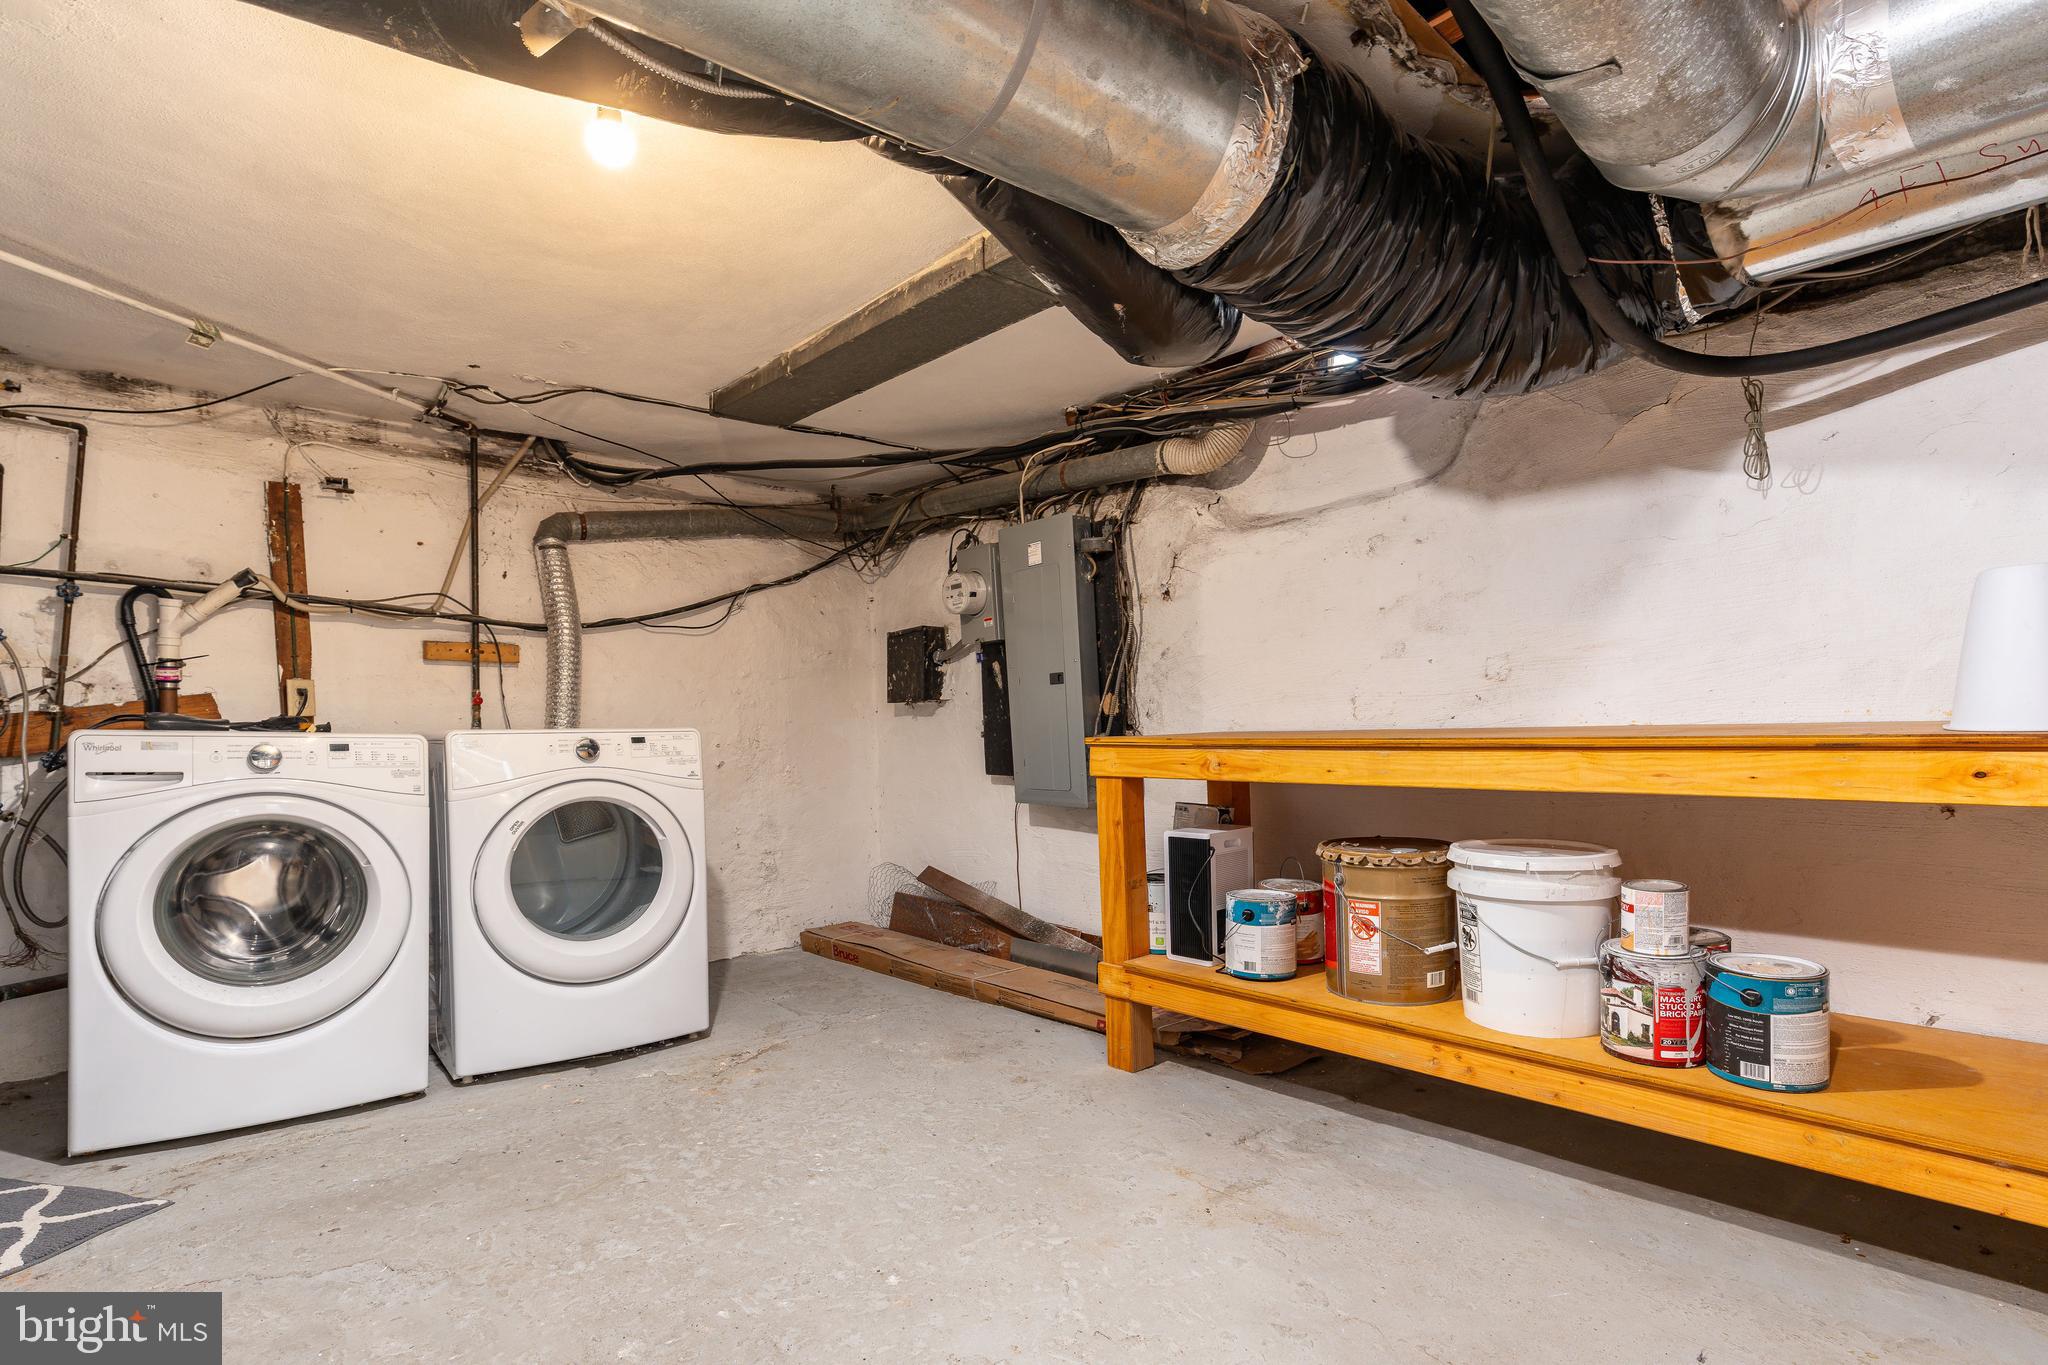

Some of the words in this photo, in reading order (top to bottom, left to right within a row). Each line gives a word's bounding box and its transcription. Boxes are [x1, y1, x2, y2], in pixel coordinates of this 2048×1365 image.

[82, 742, 122, 755] Whirlpool
[832, 944, 861, 963] Bruce
[1660, 995, 1702, 1003] MASORY,
